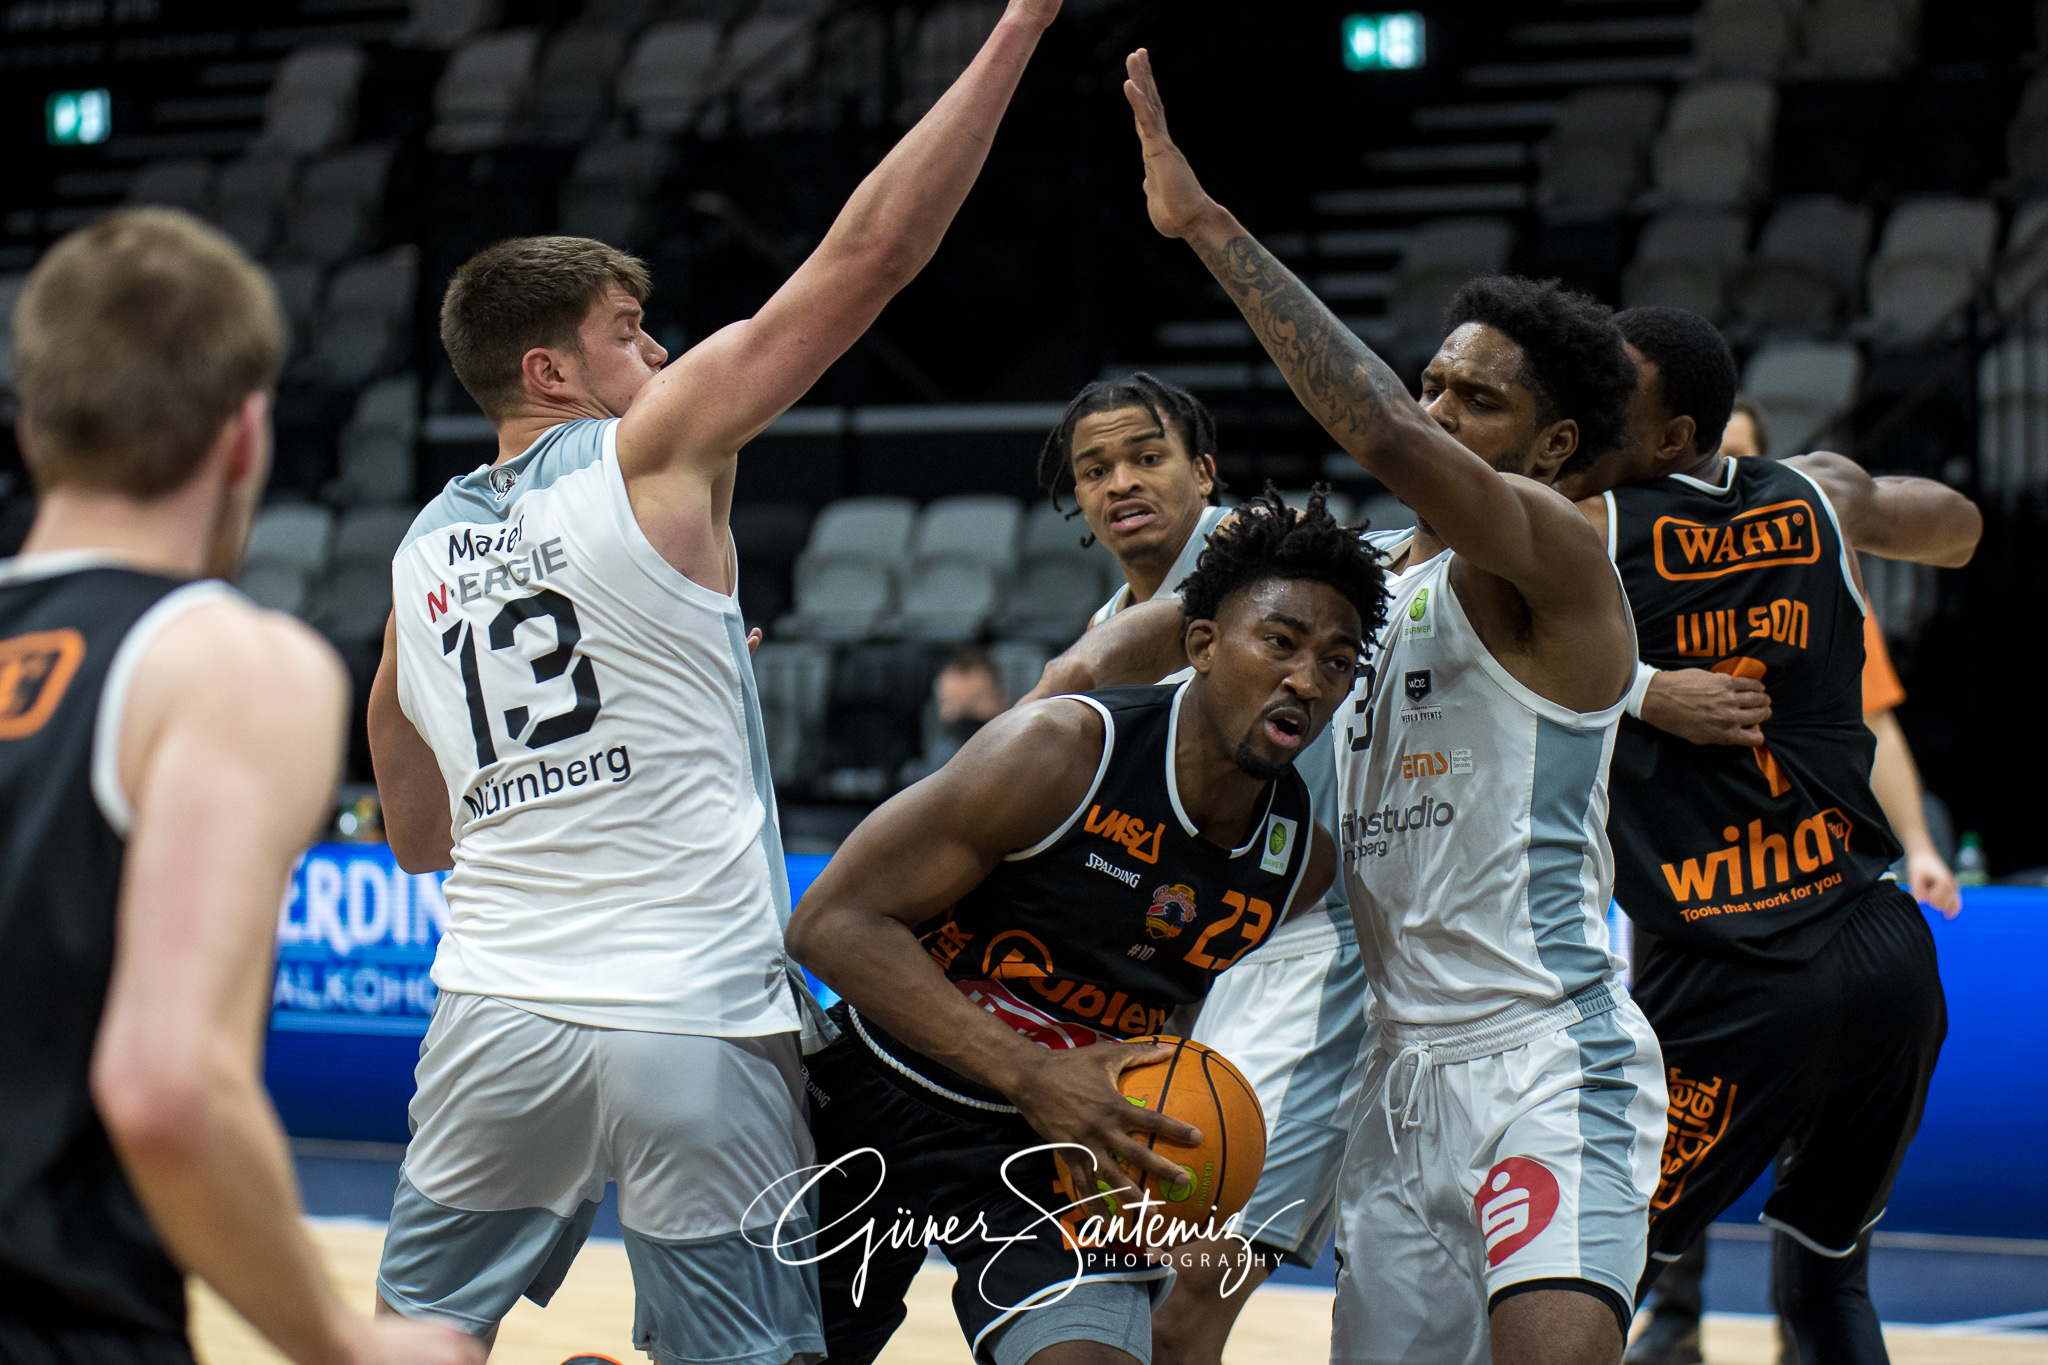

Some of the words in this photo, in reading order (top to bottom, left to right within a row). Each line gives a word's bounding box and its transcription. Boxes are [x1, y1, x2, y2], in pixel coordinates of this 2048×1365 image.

[449, 514, 525, 566] Maier
[441, 588, 602, 770] 13
[1420, 711, 1443, 721] EVENTS
[462, 744, 632, 821] Nürnberg
[1084, 851, 1141, 890] SPALDING
[1661, 812, 1834, 902] wiha
[1680, 906, 1722, 923] Tools
[1722, 901, 1752, 914] that
[1753, 892, 1790, 911] work
[1790, 884, 1812, 901] for
[1813, 873, 1842, 896] you
[1183, 890, 1272, 970] 23
[1197, 1162, 1213, 1207] BARMER
